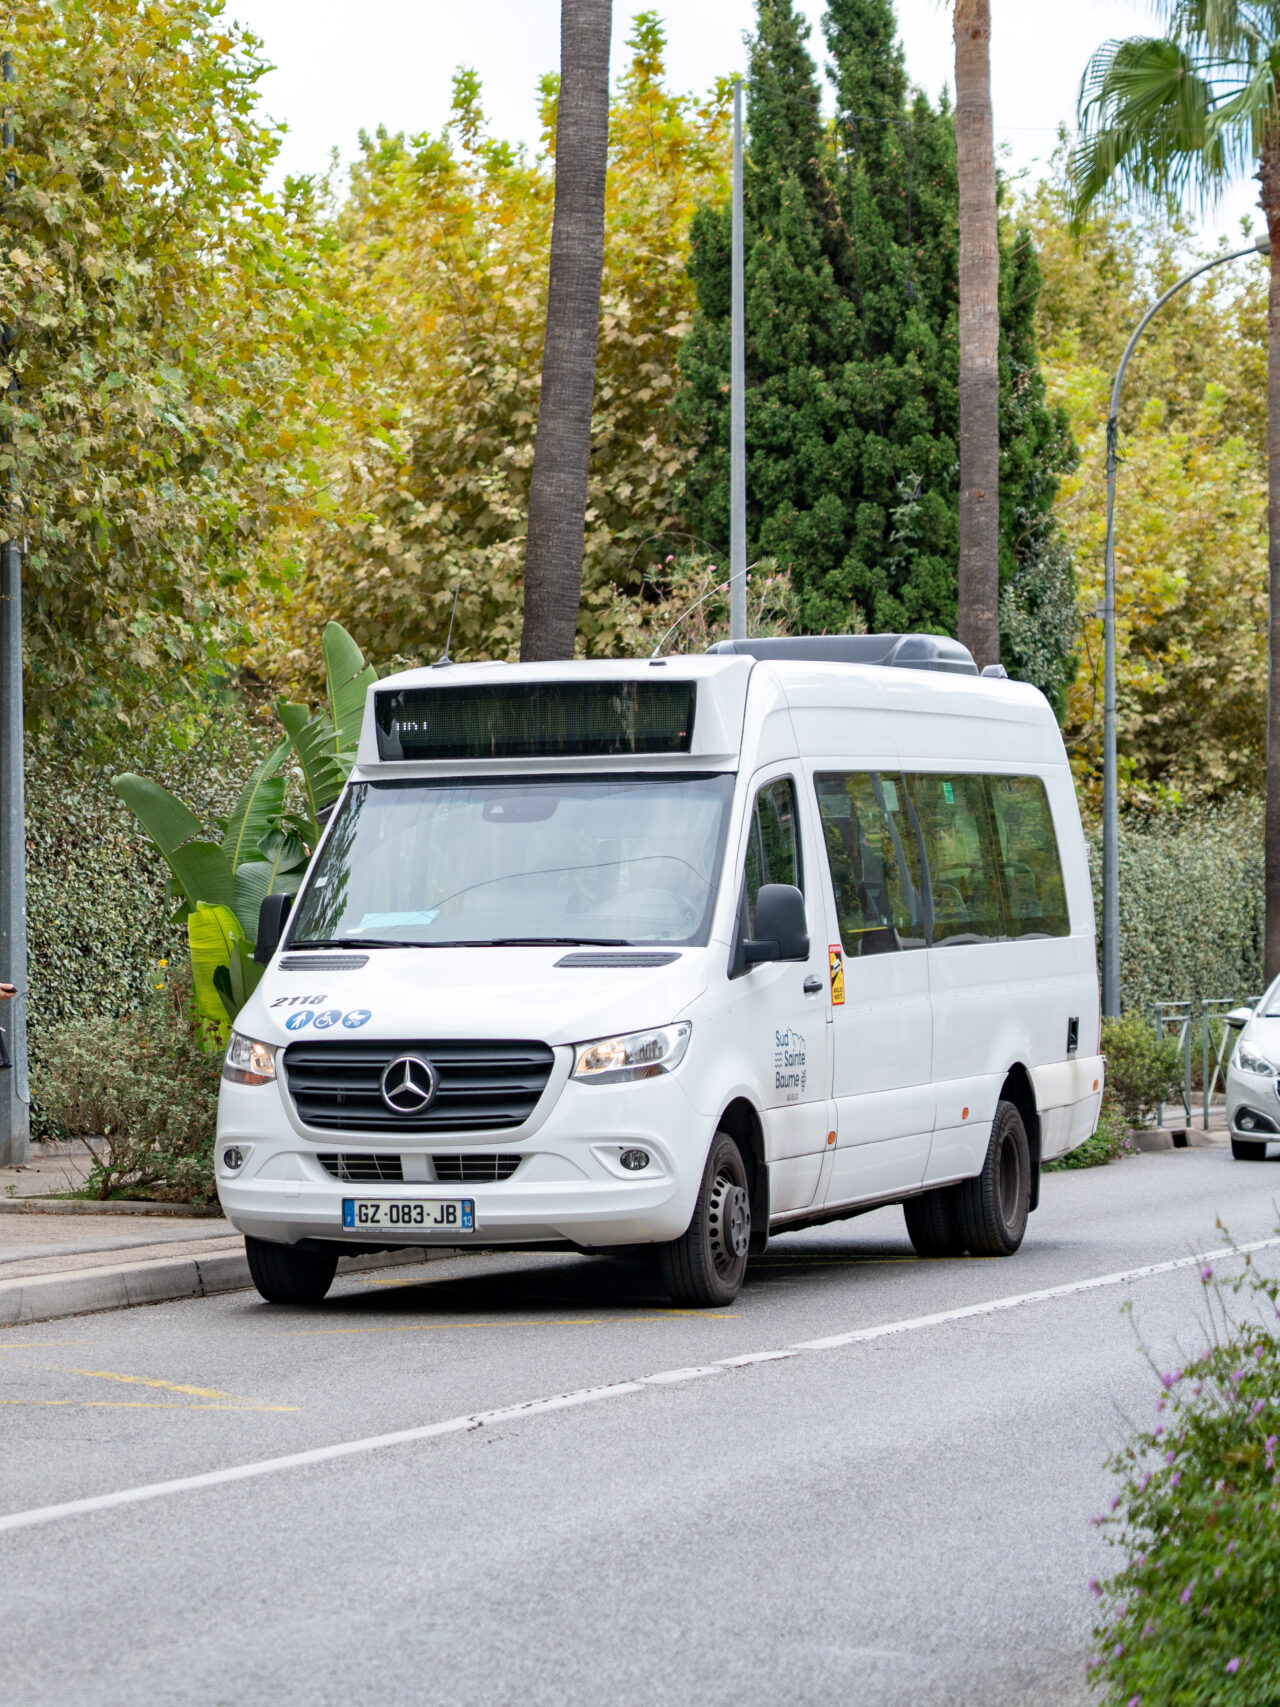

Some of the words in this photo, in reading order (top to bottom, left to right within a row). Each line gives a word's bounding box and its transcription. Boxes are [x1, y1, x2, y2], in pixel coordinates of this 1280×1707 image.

[269, 994, 328, 1008] 2118
[775, 1029, 789, 1047] Sud
[784, 1048, 806, 1067] Sainte
[775, 1071, 800, 1089] Baume
[463, 1215, 473, 1226] 13
